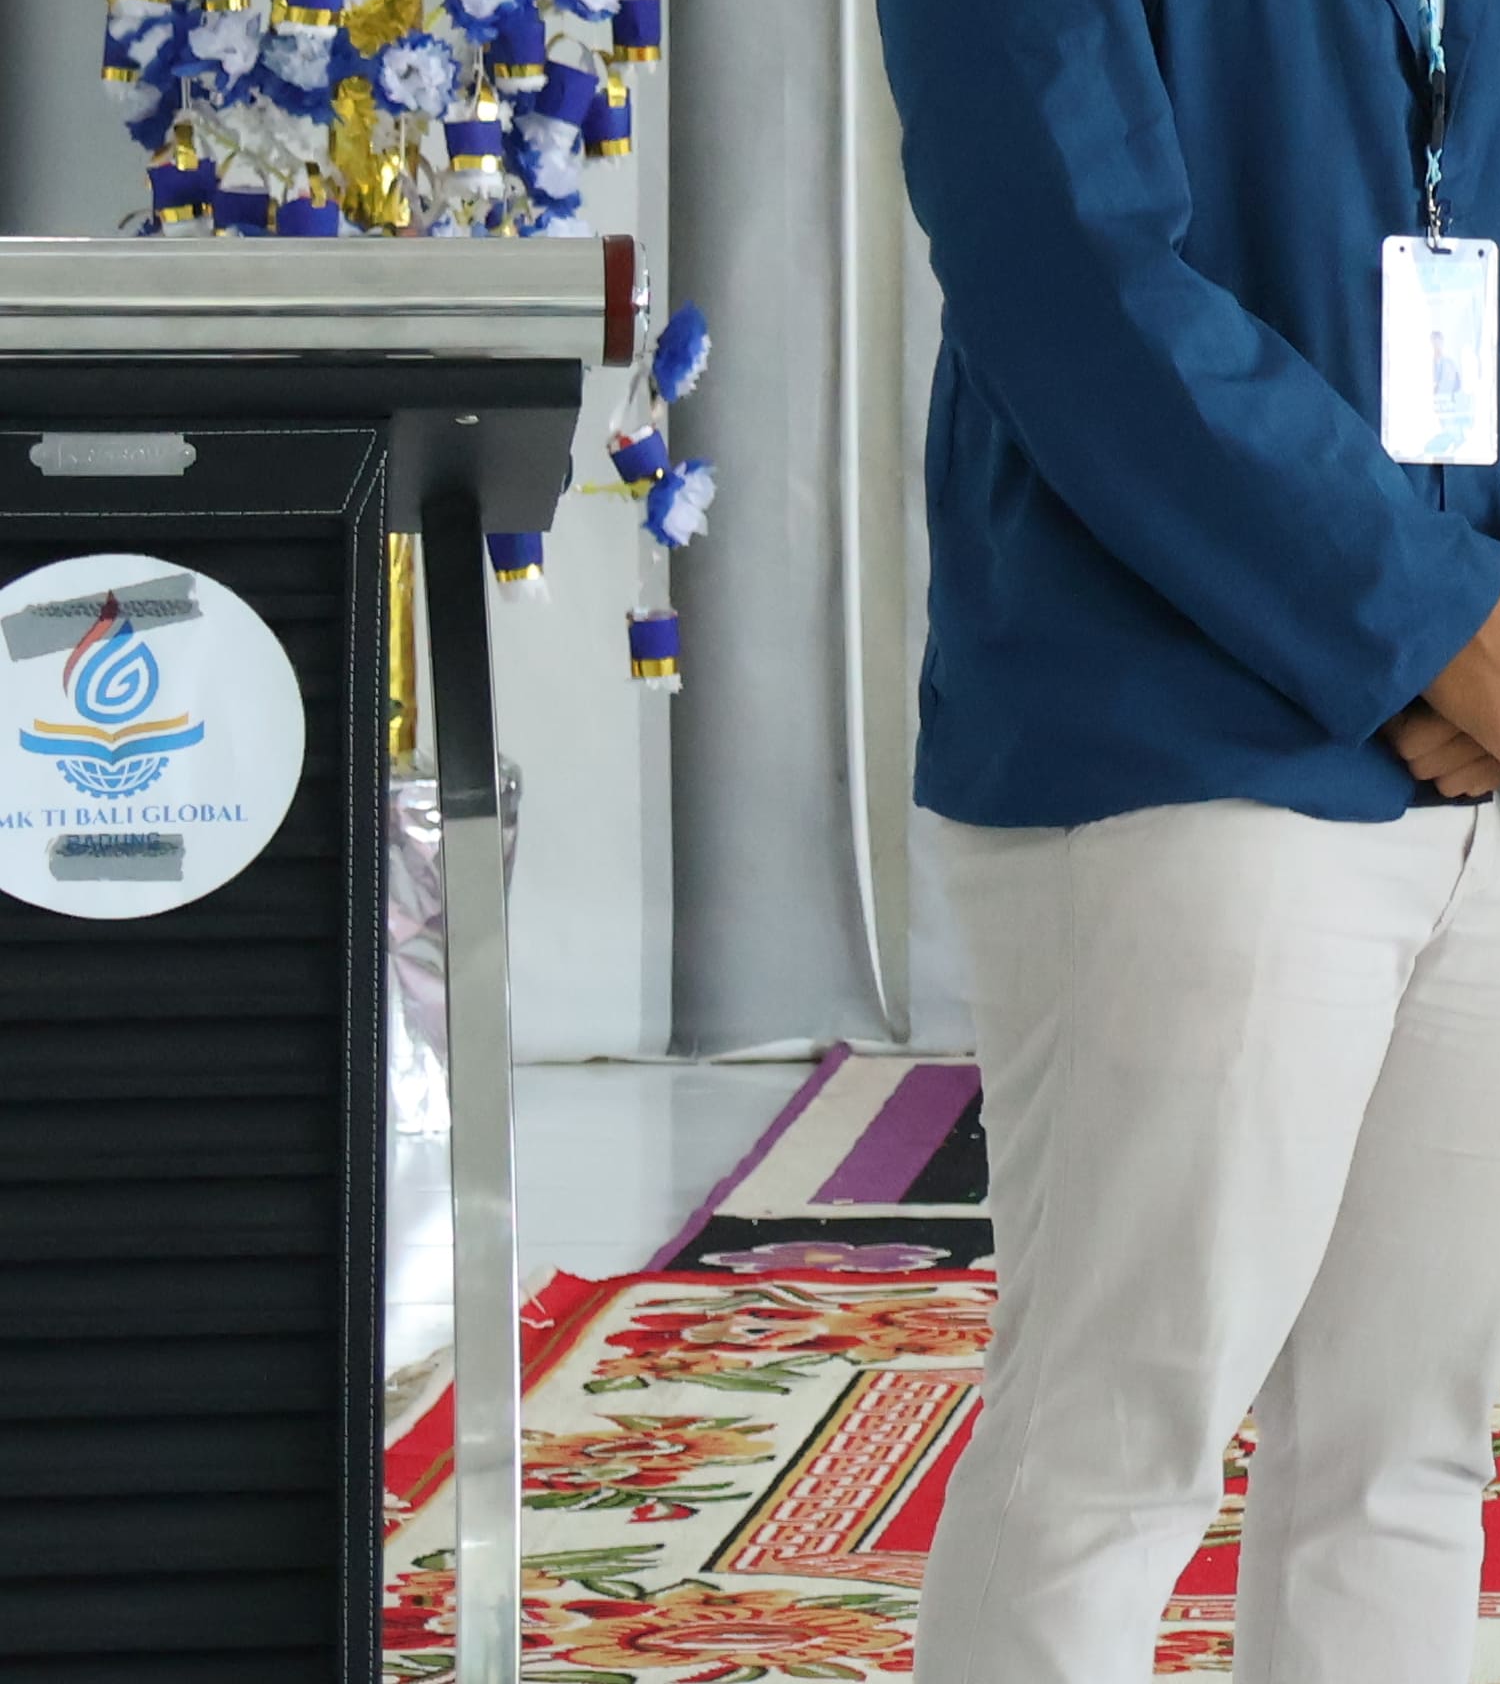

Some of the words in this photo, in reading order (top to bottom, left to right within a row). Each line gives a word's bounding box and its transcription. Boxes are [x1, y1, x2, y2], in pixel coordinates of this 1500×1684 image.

[0, 809, 34, 829] MK
[41, 809, 67, 827] TI
[75, 806, 134, 827] BALI
[142, 803, 249, 824] GLOBAL
